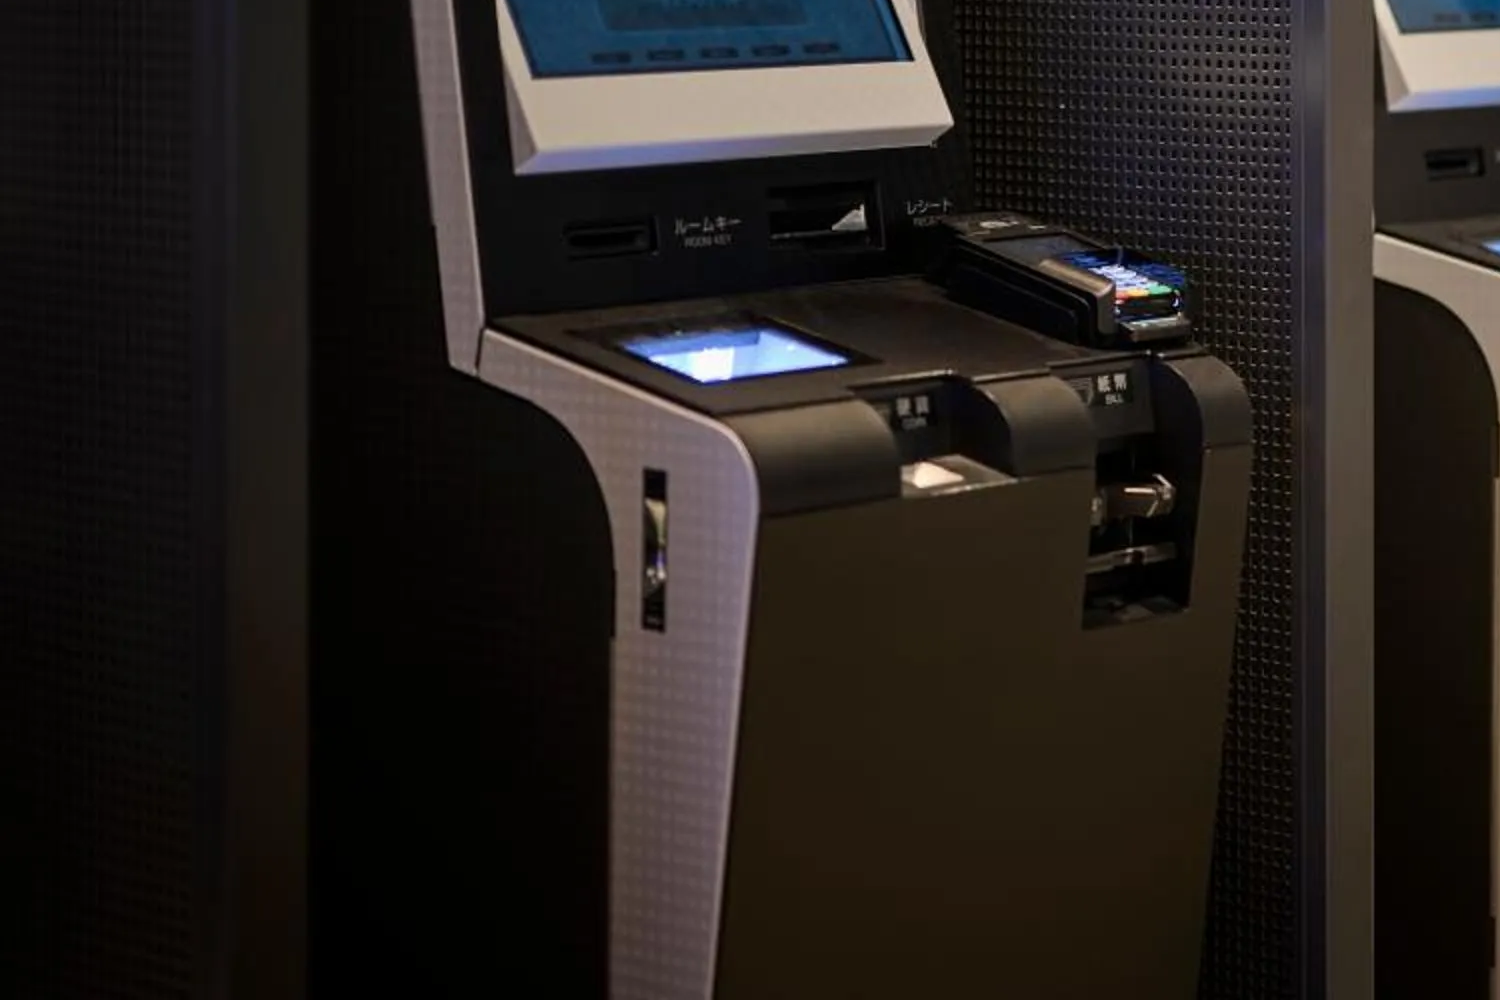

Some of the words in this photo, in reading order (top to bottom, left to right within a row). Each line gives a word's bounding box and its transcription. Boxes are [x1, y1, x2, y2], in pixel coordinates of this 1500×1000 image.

[675, 216, 742, 236] ルームキー
